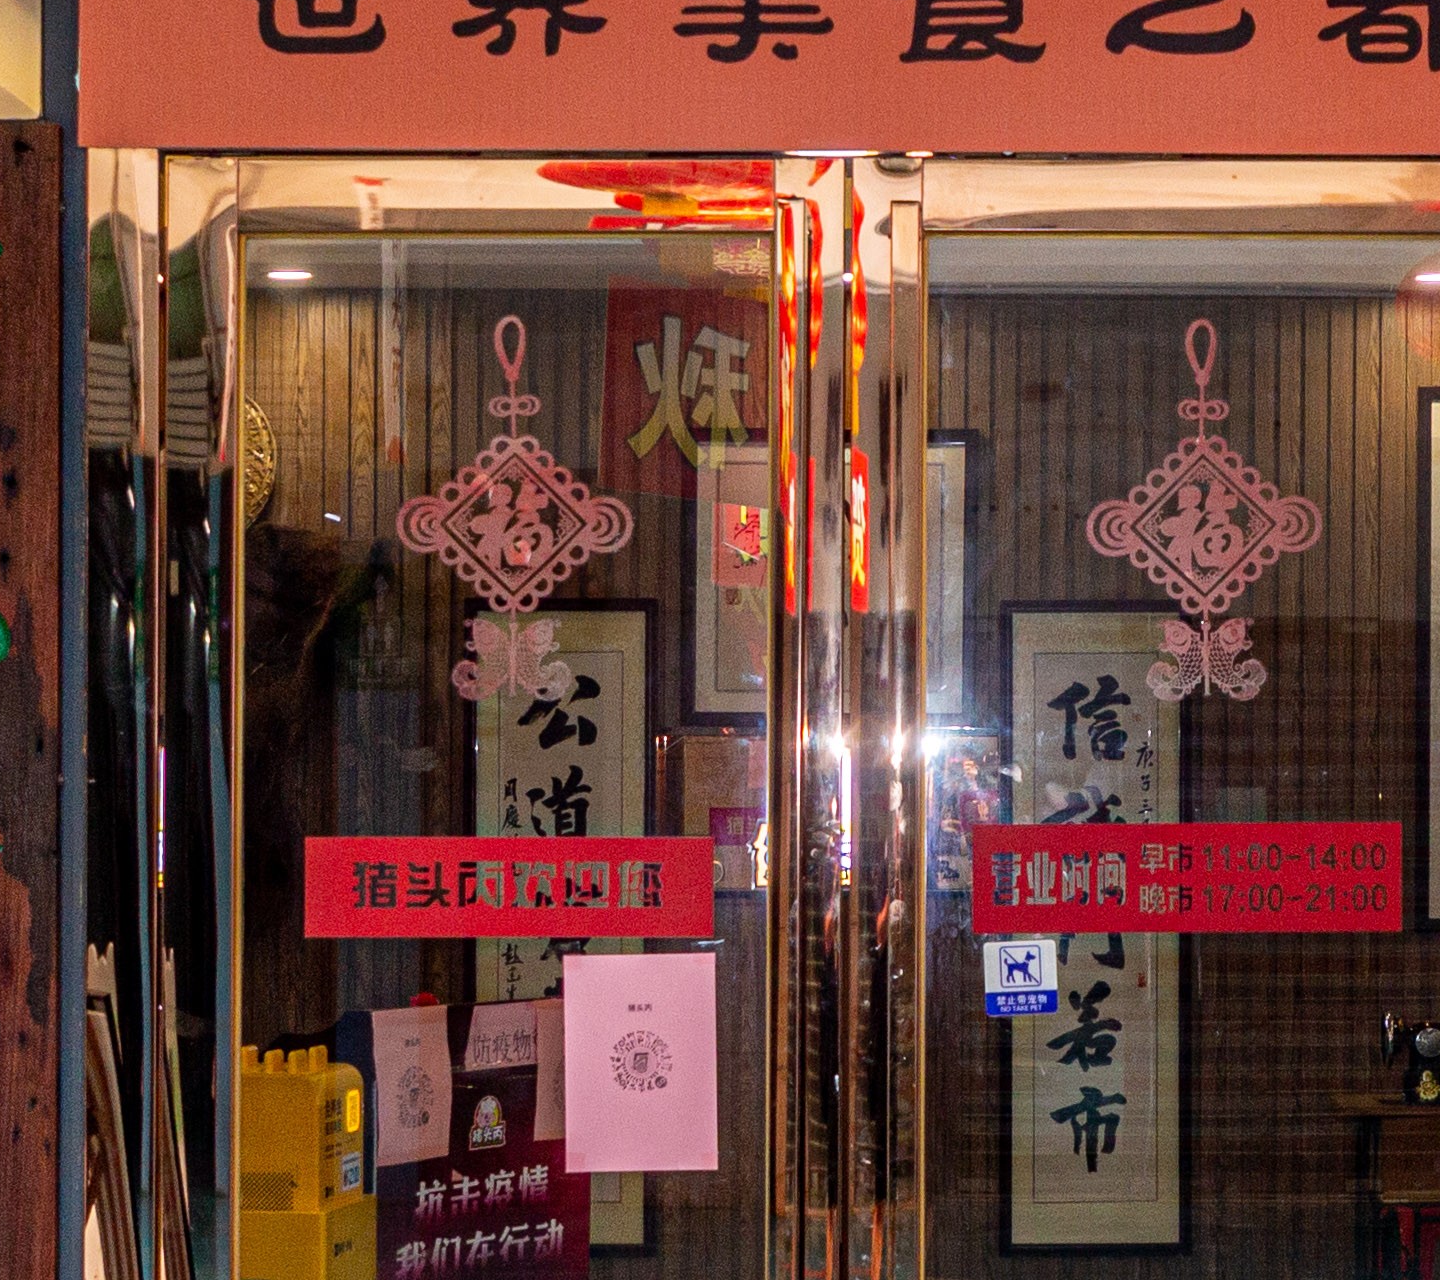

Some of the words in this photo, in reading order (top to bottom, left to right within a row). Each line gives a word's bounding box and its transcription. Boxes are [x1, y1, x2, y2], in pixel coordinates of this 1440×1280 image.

[1160, 485, 1243, 570] 福
[991, 851, 1127, 907] 营业时间
[1139, 842, 1194, 873] 早市
[1202, 843, 1387, 872] 11:00-14:00
[351, 860, 664, 910] 猪头丙欢迎您
[1139, 884, 1194, 914] 晚市
[1202, 884, 1388, 913] 17:00-21:00
[997, 994, 1047, 1006] 禁止带宠物
[415, 1165, 550, 1216] 抗击疫情
[396, 1218, 565, 1278] 我们在行动
